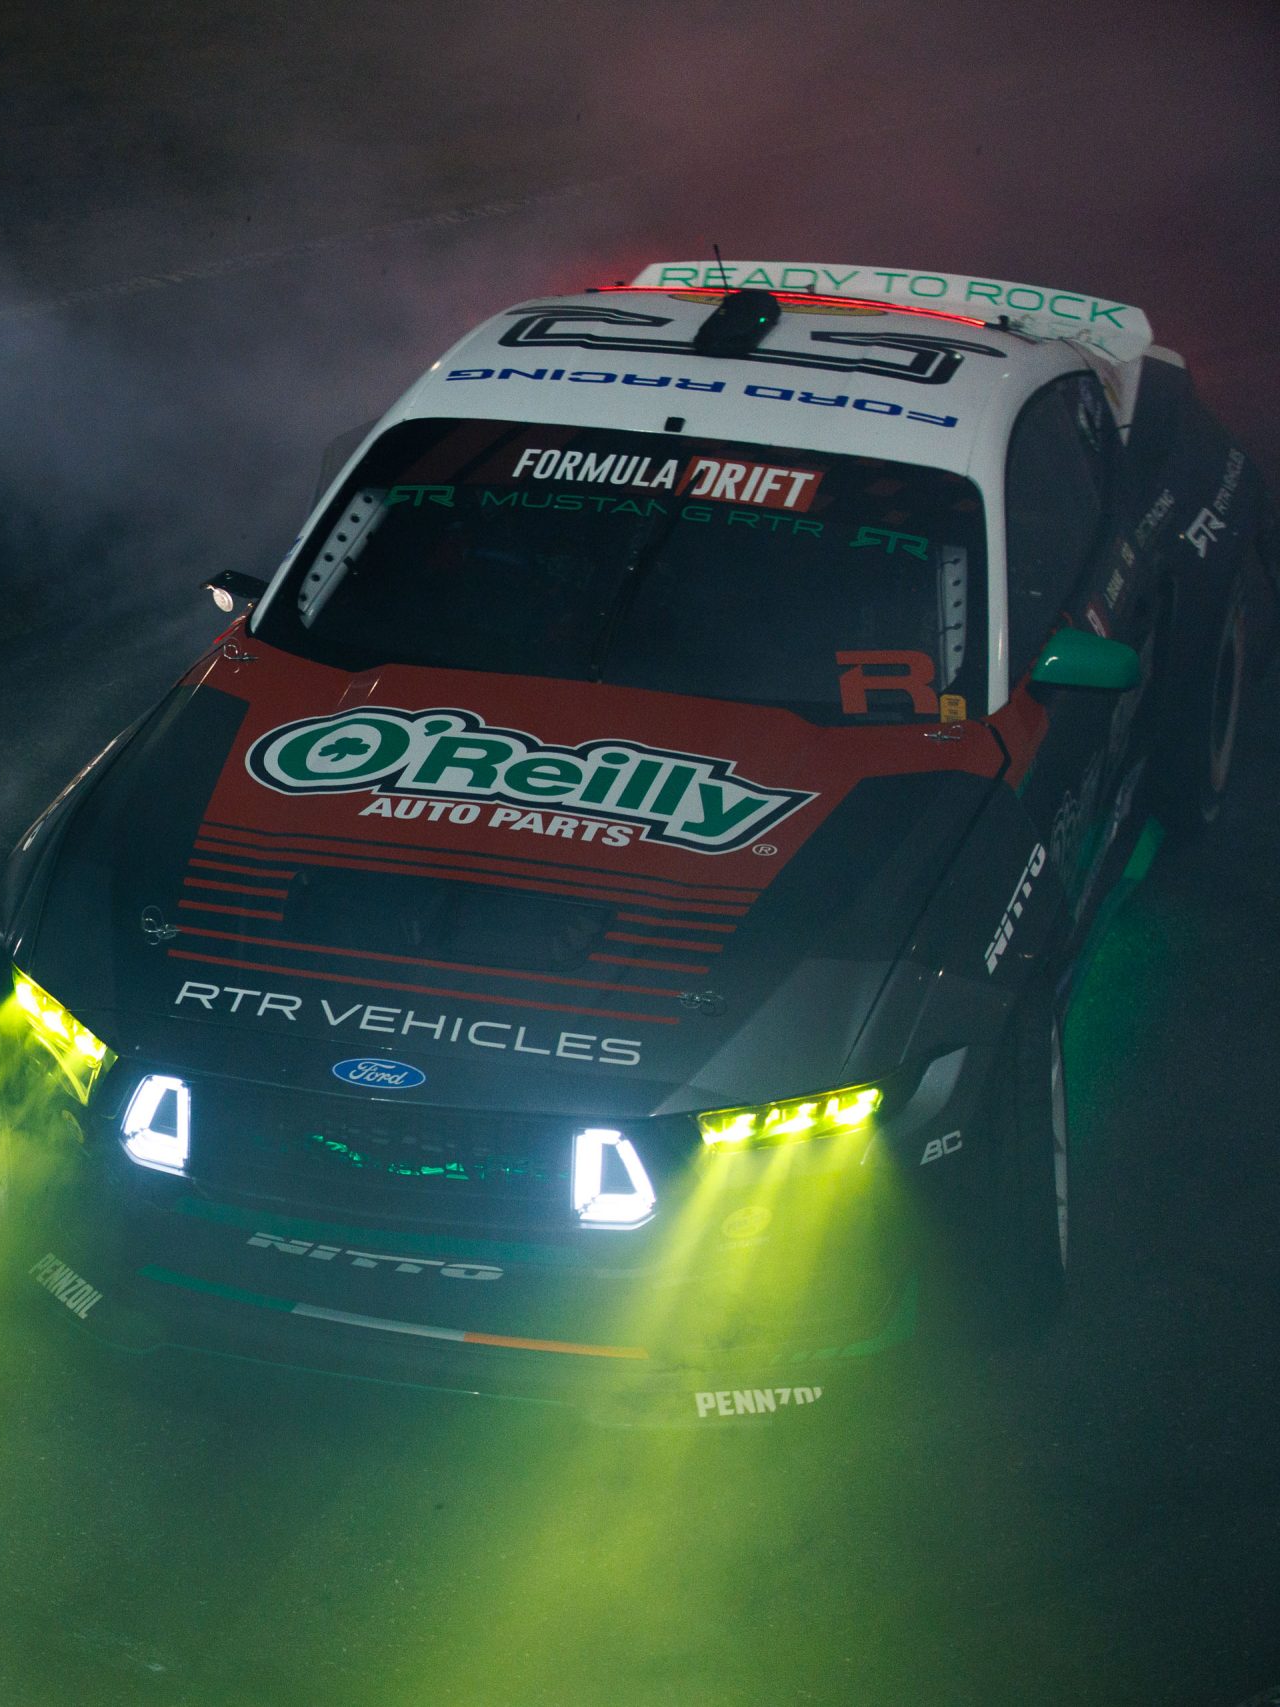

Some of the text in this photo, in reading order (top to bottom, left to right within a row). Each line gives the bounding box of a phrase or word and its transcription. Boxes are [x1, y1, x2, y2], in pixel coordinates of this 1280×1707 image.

[658, 266, 1127, 329] READY TO ROCK
[445, 367, 959, 429] FORD RACING
[512, 447, 817, 508] FORMULA DRIFT
[480, 489, 714, 525] MUSTANG
[726, 509, 825, 538] RTR
[835, 651, 939, 714] R
[263, 709, 788, 843] O'Reilly
[358, 796, 636, 848] AUTO PARTS
[984, 842, 1047, 976] NITTO
[175, 980, 643, 1066] RTR VEHICLES
[348, 1059, 410, 1088] Ford
[920, 1129, 963, 1166] BC
[28, 1252, 104, 1320] PENNZOIL
[246, 1231, 505, 1281] NITTO
